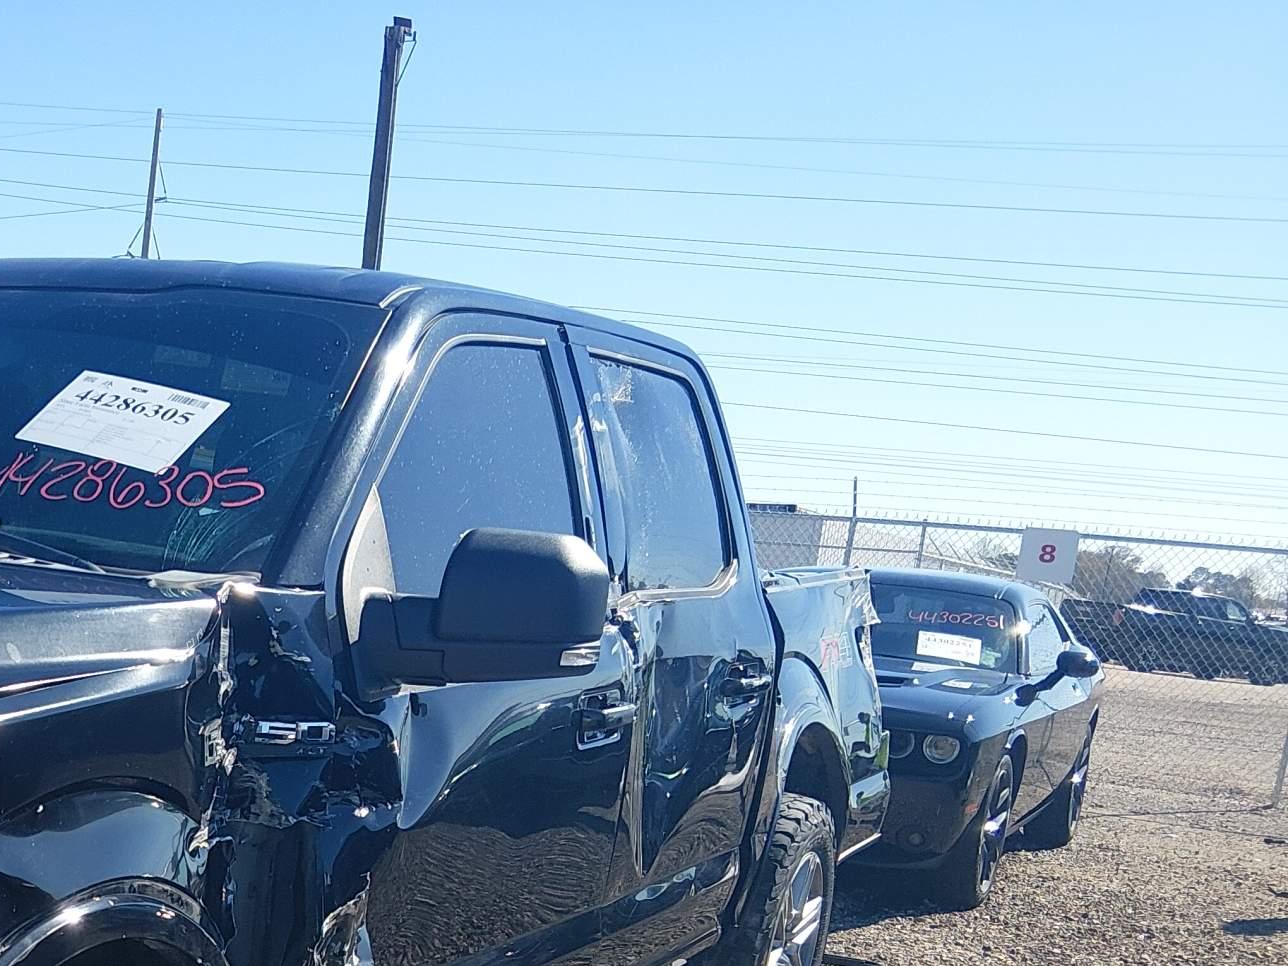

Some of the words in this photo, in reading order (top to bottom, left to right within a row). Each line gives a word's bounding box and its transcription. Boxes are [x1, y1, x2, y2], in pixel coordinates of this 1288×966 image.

[74, 389, 195, 425] 44286305
[1039, 544, 1056, 563] 8
[908, 609, 1004, 630] 44302251
